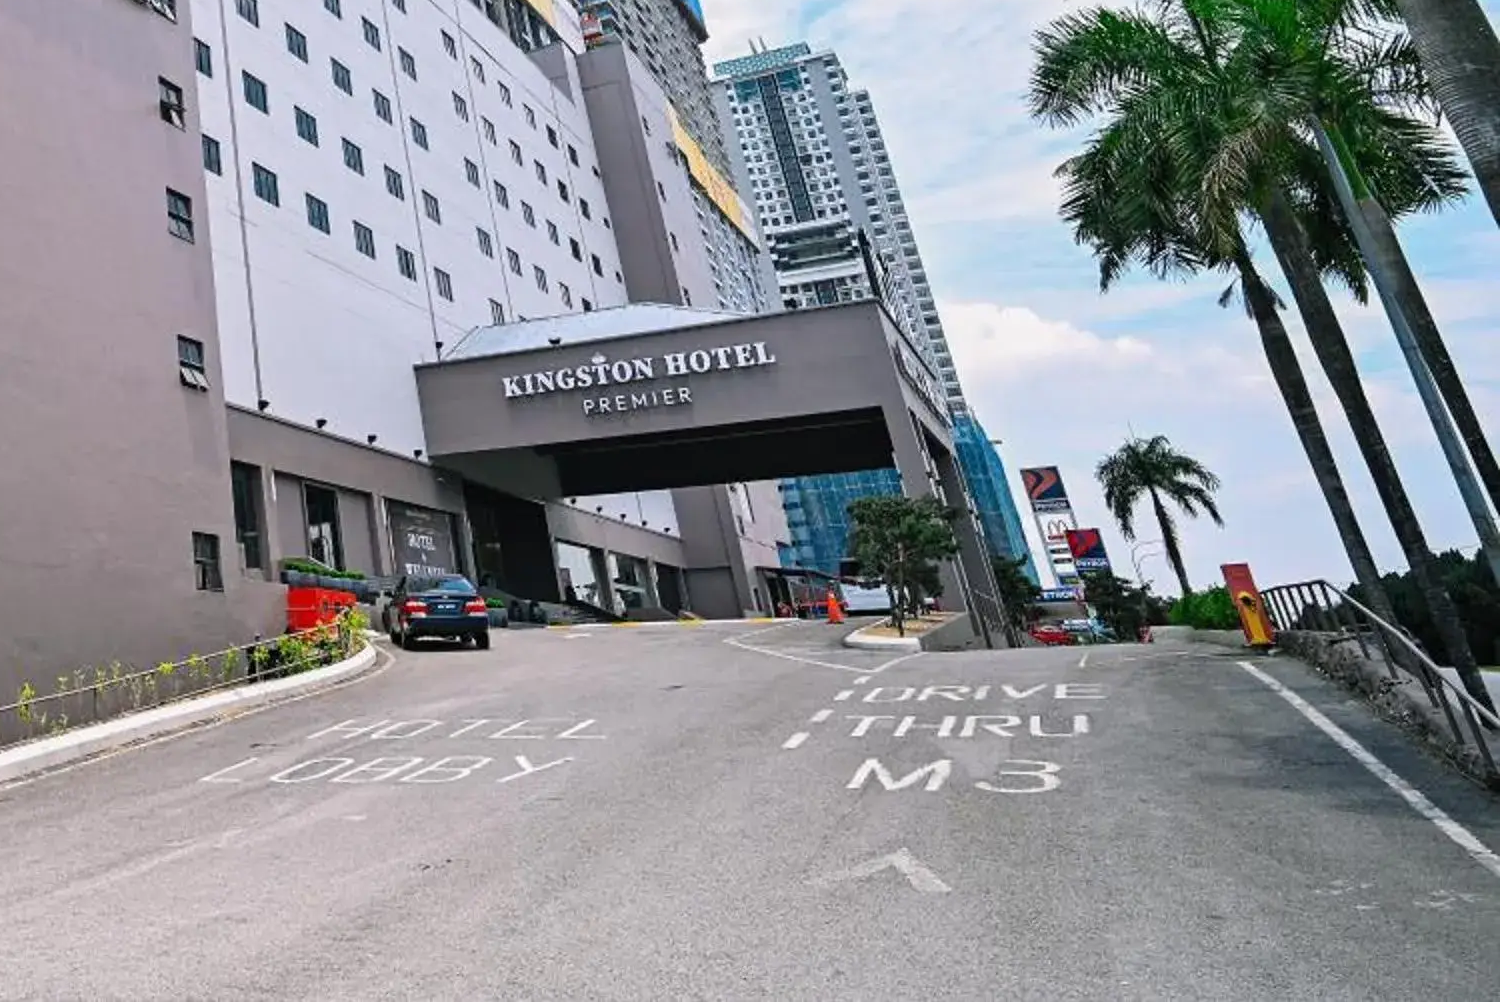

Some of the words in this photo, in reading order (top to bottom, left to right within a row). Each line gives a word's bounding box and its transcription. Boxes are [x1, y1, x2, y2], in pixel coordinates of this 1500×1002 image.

[502, 357, 654, 398] KINGSTON
[663, 341, 777, 377] HOTEL
[583, 386, 693, 415] PREMIER
[862, 683, 1109, 703] DRIVE
[305, 718, 608, 740] HOTEL
[844, 715, 1091, 738] THRU
[199, 755, 575, 784] LOBBY
